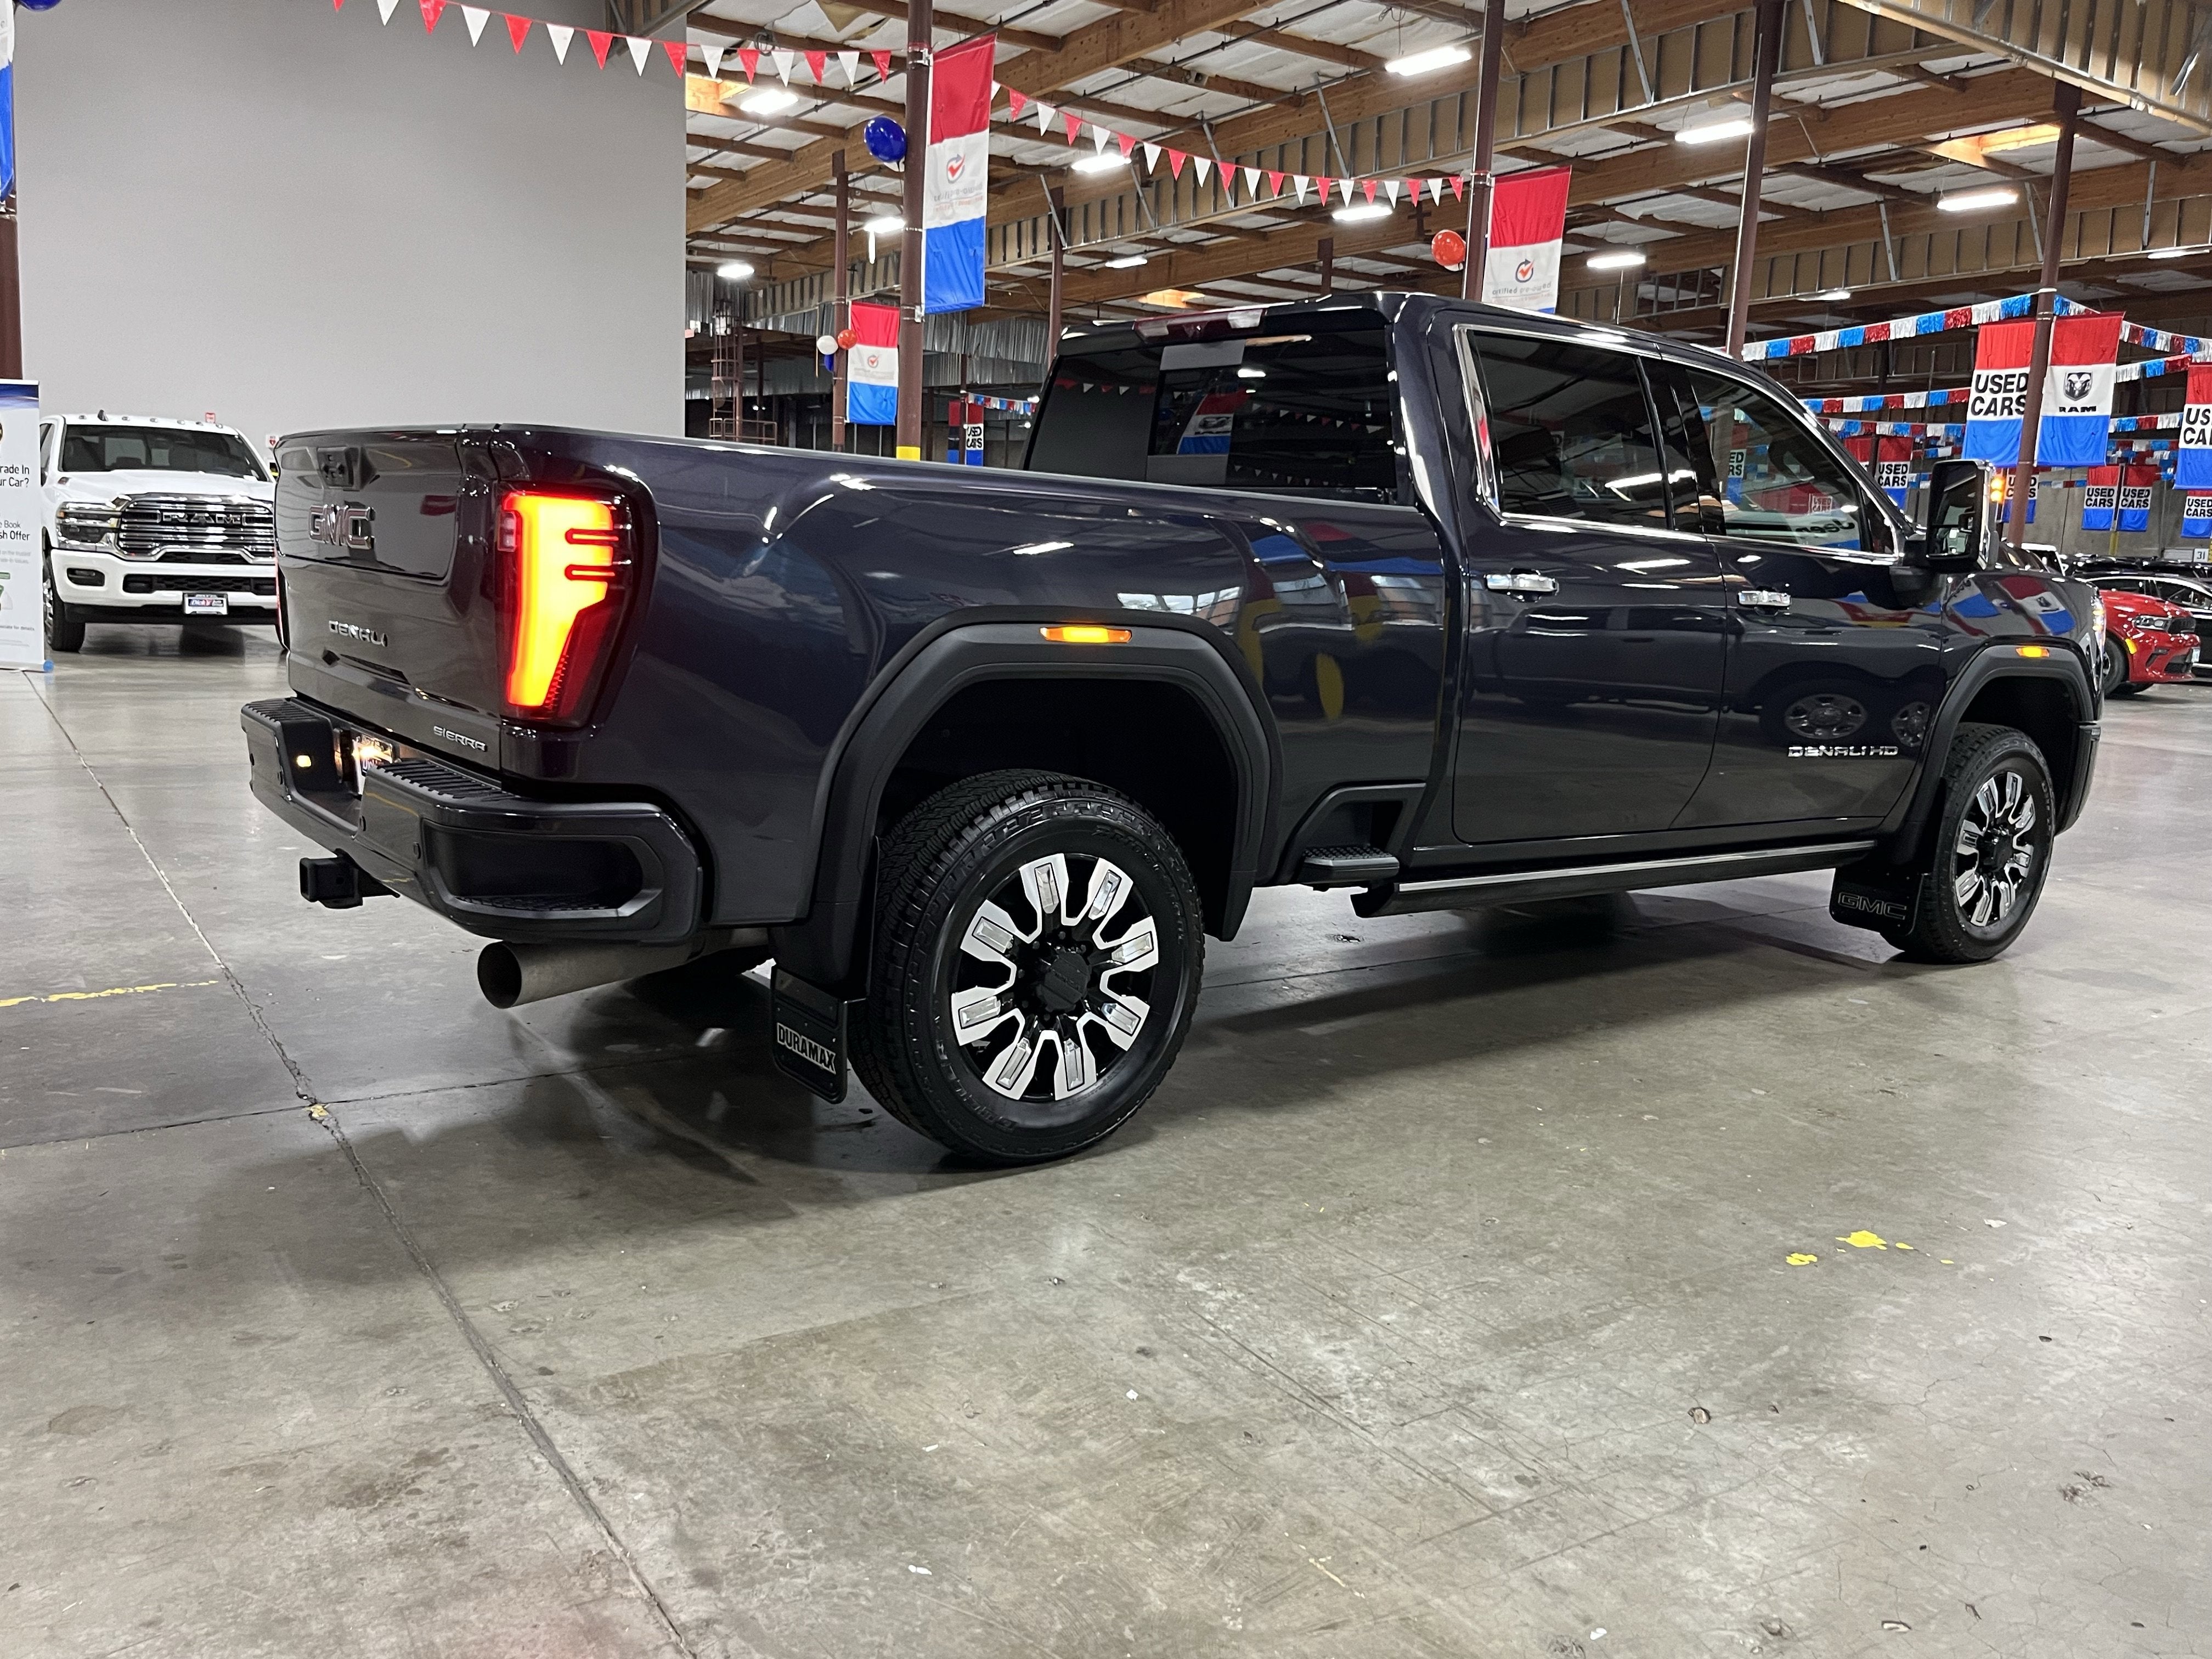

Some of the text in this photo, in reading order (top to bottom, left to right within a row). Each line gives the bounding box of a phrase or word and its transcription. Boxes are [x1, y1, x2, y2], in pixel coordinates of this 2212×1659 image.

[1974, 373, 2029, 394] USED
[1971, 394, 2027, 416] CARS
[2186, 408, 2212, 425] US
[2183, 427, 2212, 445] CA
[1729, 452, 1744, 463] ED
[22, 464, 30, 475] In
[1728, 464, 1742, 476] RS
[1878, 464, 1908, 475] USED
[9, 477, 29, 488] Car?
[1877, 476, 1906, 487] CARS
[2008, 477, 2037, 487] UD
[2006, 488, 2036, 498] CS
[2087, 488, 2115, 497] USED
[2122, 488, 2151, 498] USED
[2085, 498, 2113, 507] CARS
[2121, 499, 2149, 508] CARS
[163, 512, 241, 524] RAM
[4, 520, 21, 528] Book
[308, 504, 376, 550] GMC
[10, 530, 30, 540] Offer
[2197, 551, 2205, 560] 31
[329, 620, 388, 647] DENALI
[433, 725, 486, 752] SIERRA
[1787, 745, 1898, 757] DENALI HD
[1838, 891, 1907, 920] GMC
[777, 1022, 837, 1075] DURAMAX
